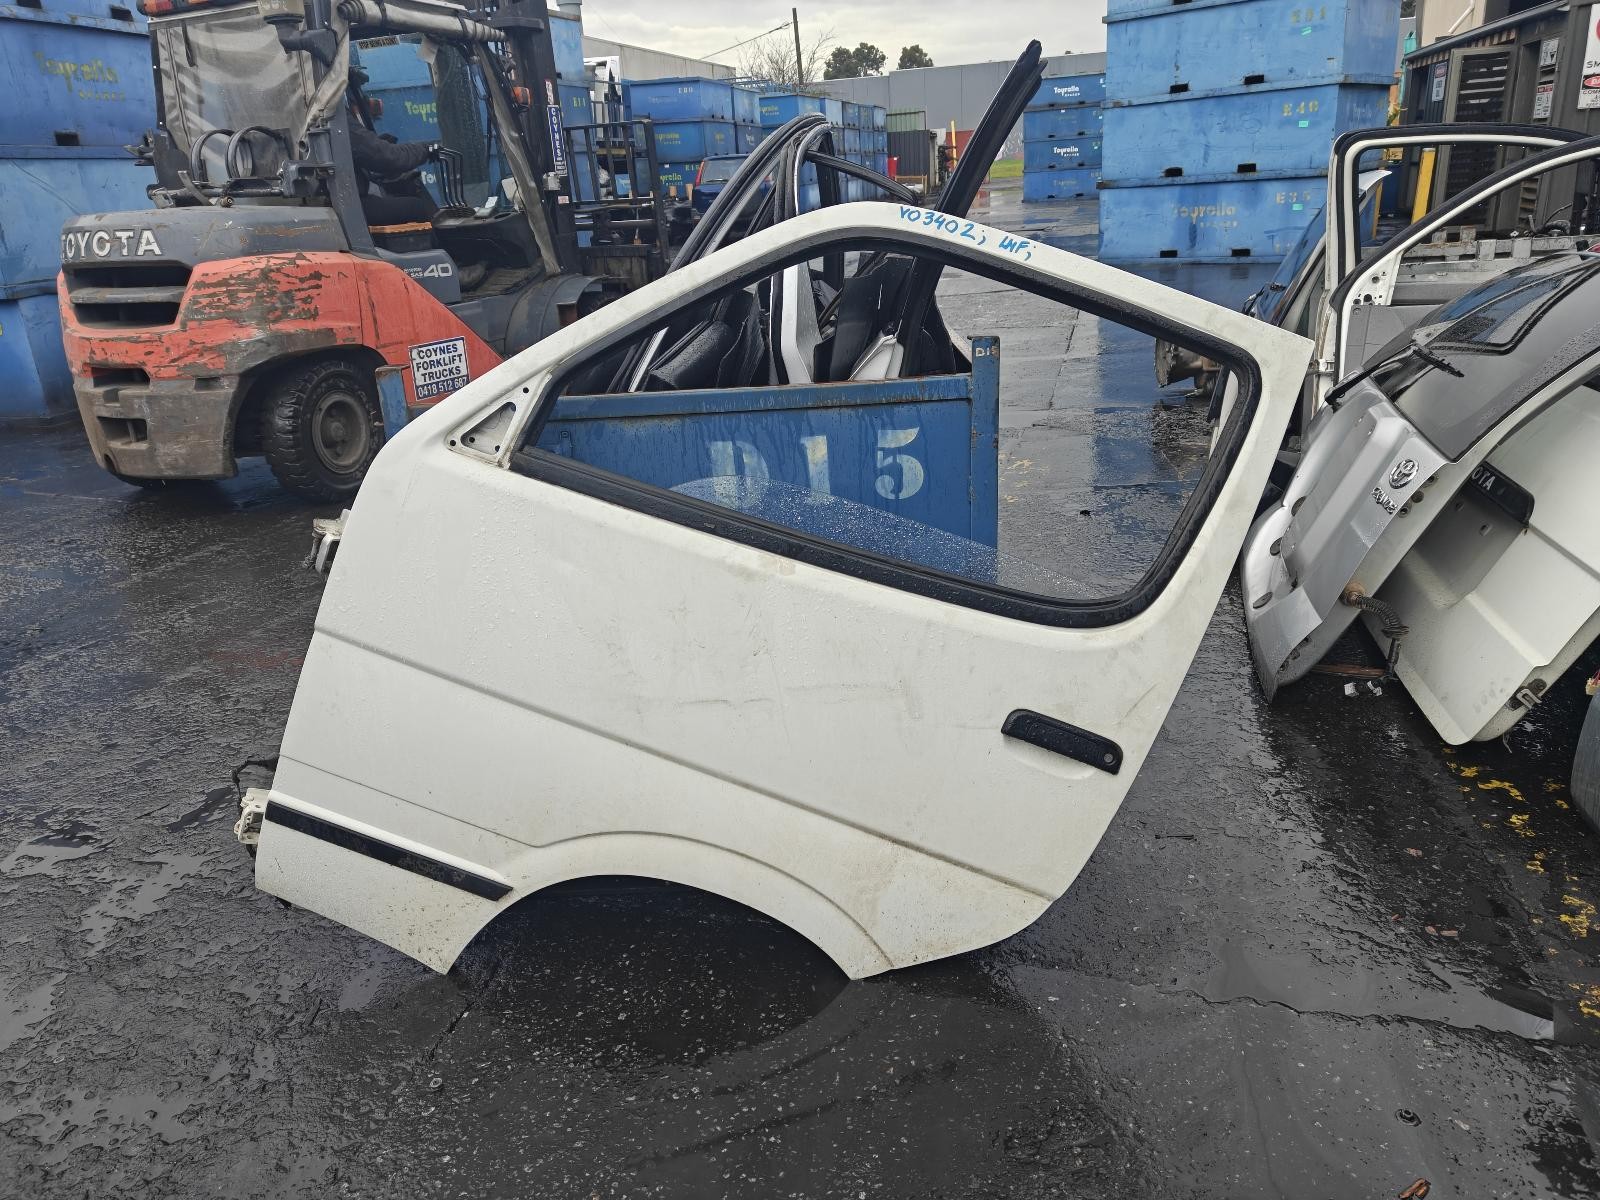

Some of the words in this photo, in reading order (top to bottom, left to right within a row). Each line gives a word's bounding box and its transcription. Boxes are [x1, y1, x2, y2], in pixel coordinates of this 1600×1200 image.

[424, 263, 453, 278] 40
[417, 343, 458, 360] COYNES
[416, 353, 463, 373] FORKLIFT
[421, 365, 462, 383] TRUCKS
[418, 383, 438, 398] 0418
[438, 380, 453, 392] 512
